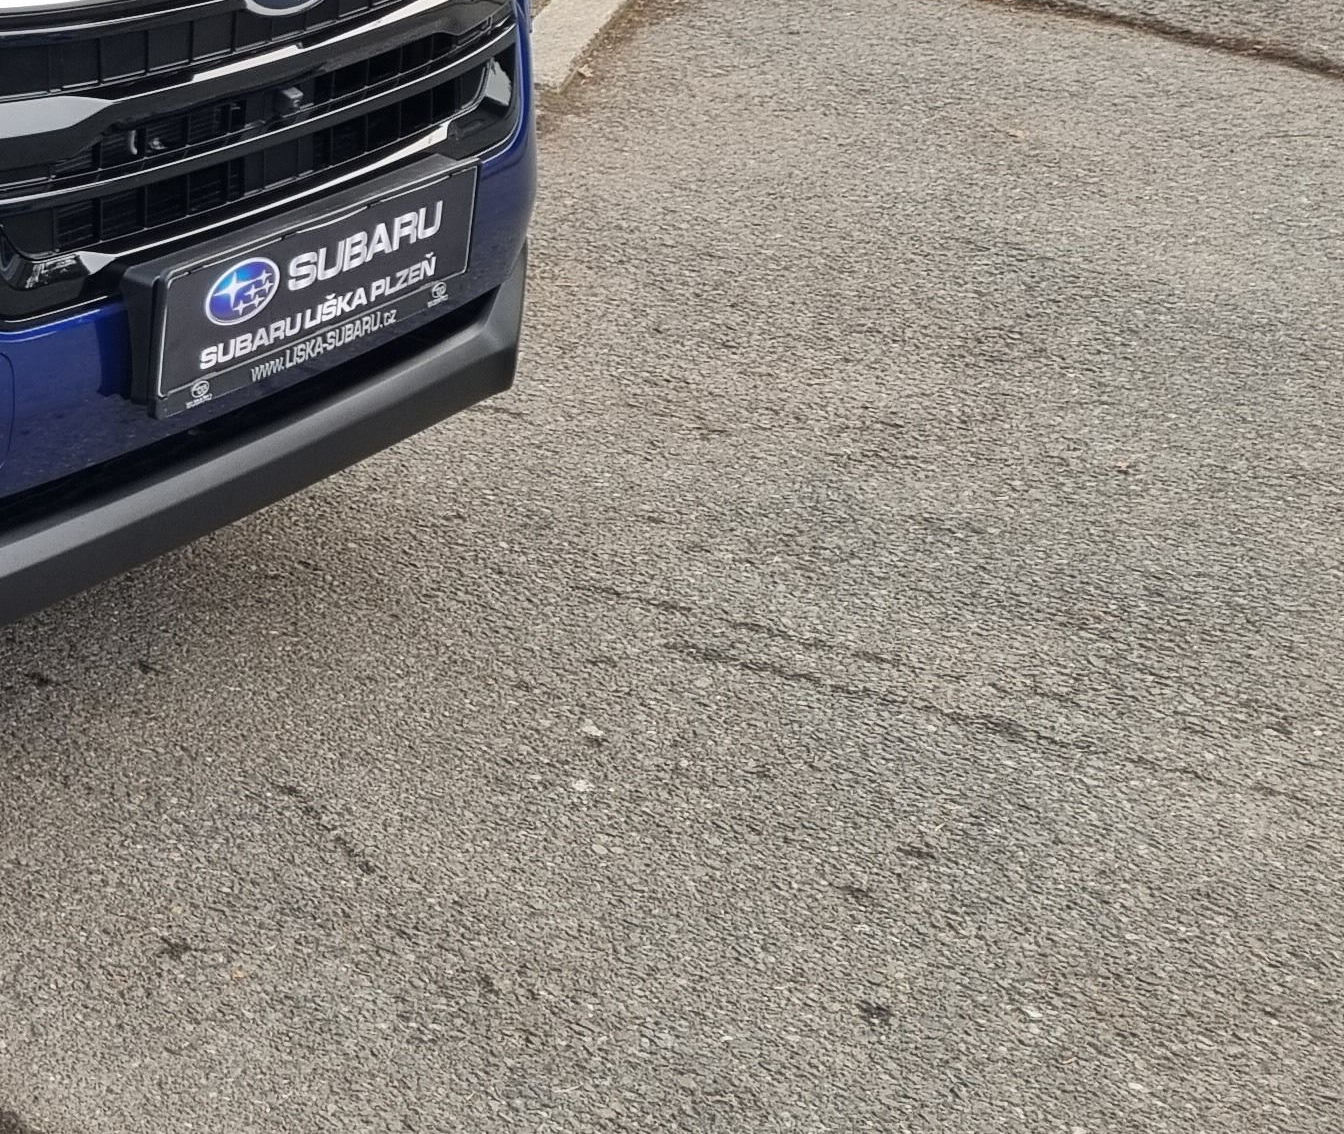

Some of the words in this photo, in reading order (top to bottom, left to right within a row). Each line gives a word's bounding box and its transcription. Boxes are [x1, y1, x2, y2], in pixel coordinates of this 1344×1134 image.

[287, 200, 444, 292] SUBARU
[200, 312, 303, 370] SUBARU
[304, 287, 368, 329] LIŠKA
[369, 252, 437, 302] PLZEŇ
